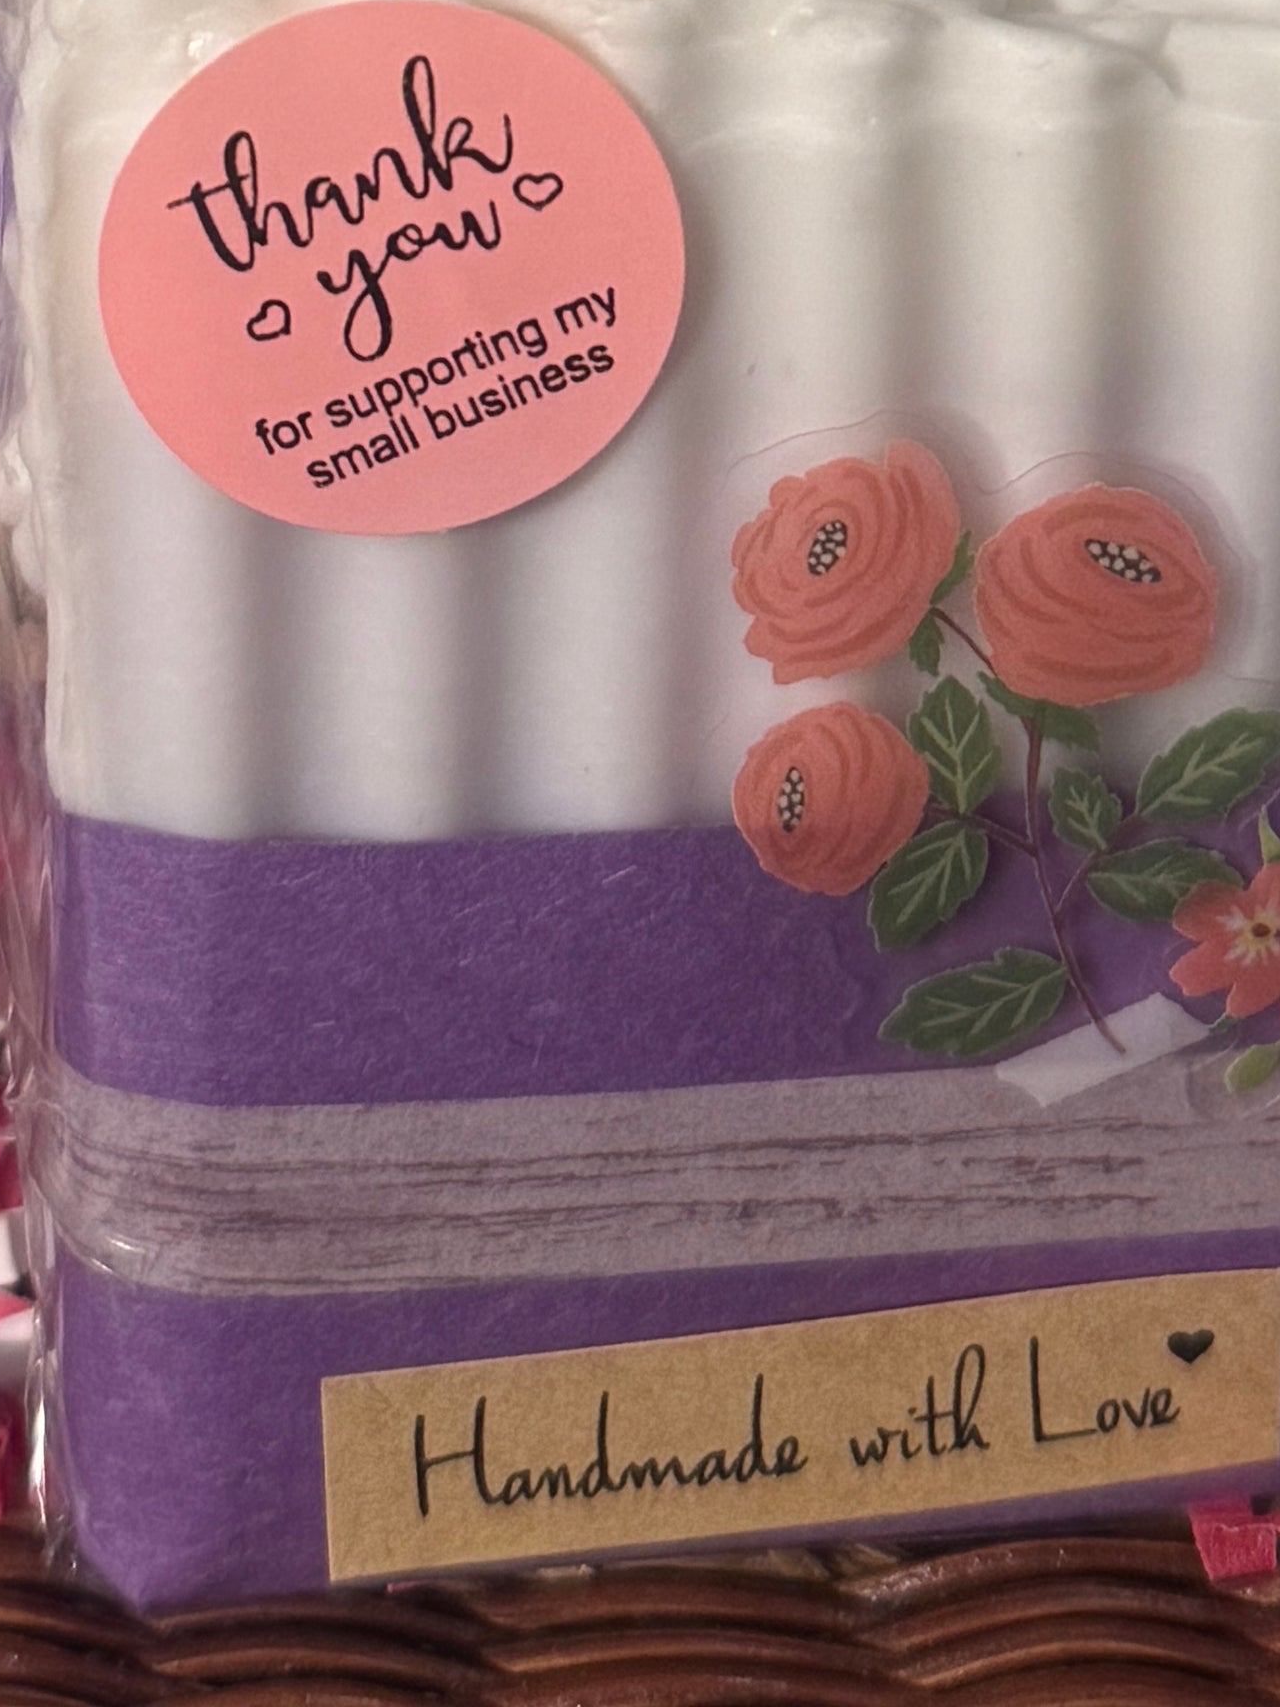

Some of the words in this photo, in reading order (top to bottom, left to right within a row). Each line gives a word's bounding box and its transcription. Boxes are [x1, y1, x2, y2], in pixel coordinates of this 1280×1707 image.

[166, 54, 514, 272] thank
[315, 199, 503, 363] you
[254, 409, 315, 456] for
[323, 316, 549, 431] supporting
[552, 286, 618, 335] my
[306, 415, 421, 490] small
[423, 341, 616, 440] business
[412, 1373, 810, 1518] Handmade
[849, 1342, 990, 1471] with
[1028, 1335, 1181, 1446] Love
